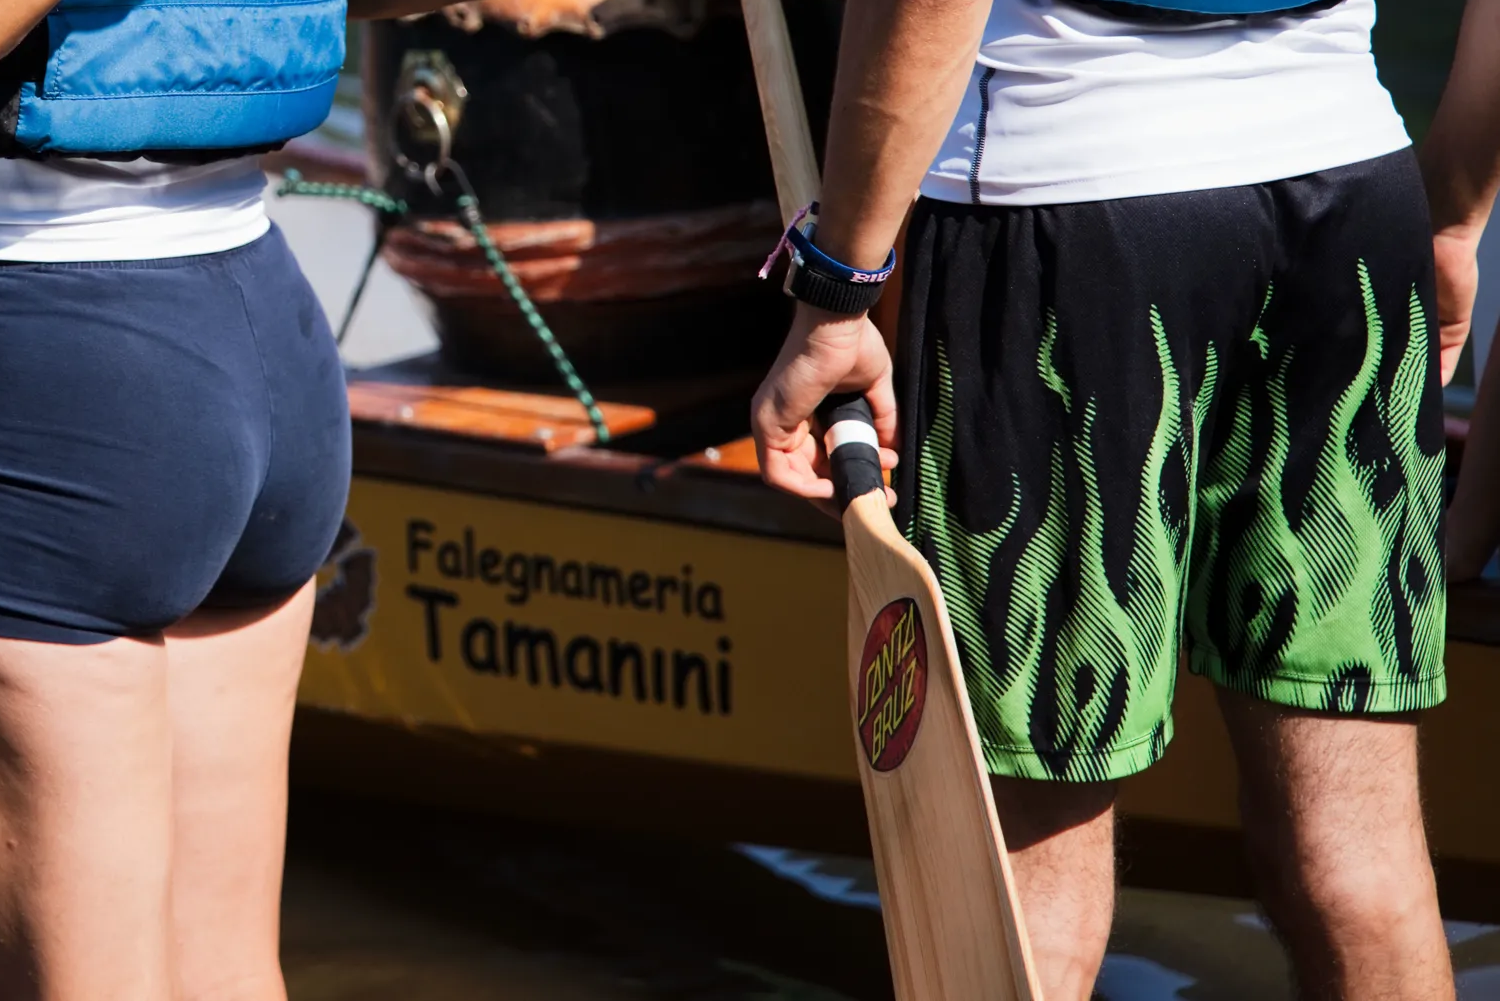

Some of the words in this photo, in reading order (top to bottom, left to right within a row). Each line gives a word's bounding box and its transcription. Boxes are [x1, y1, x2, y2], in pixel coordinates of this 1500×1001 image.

[405, 517, 726, 622] Falegnameria
[858, 602, 916, 728] SANTA
[872, 656, 918, 766] BRUZ
